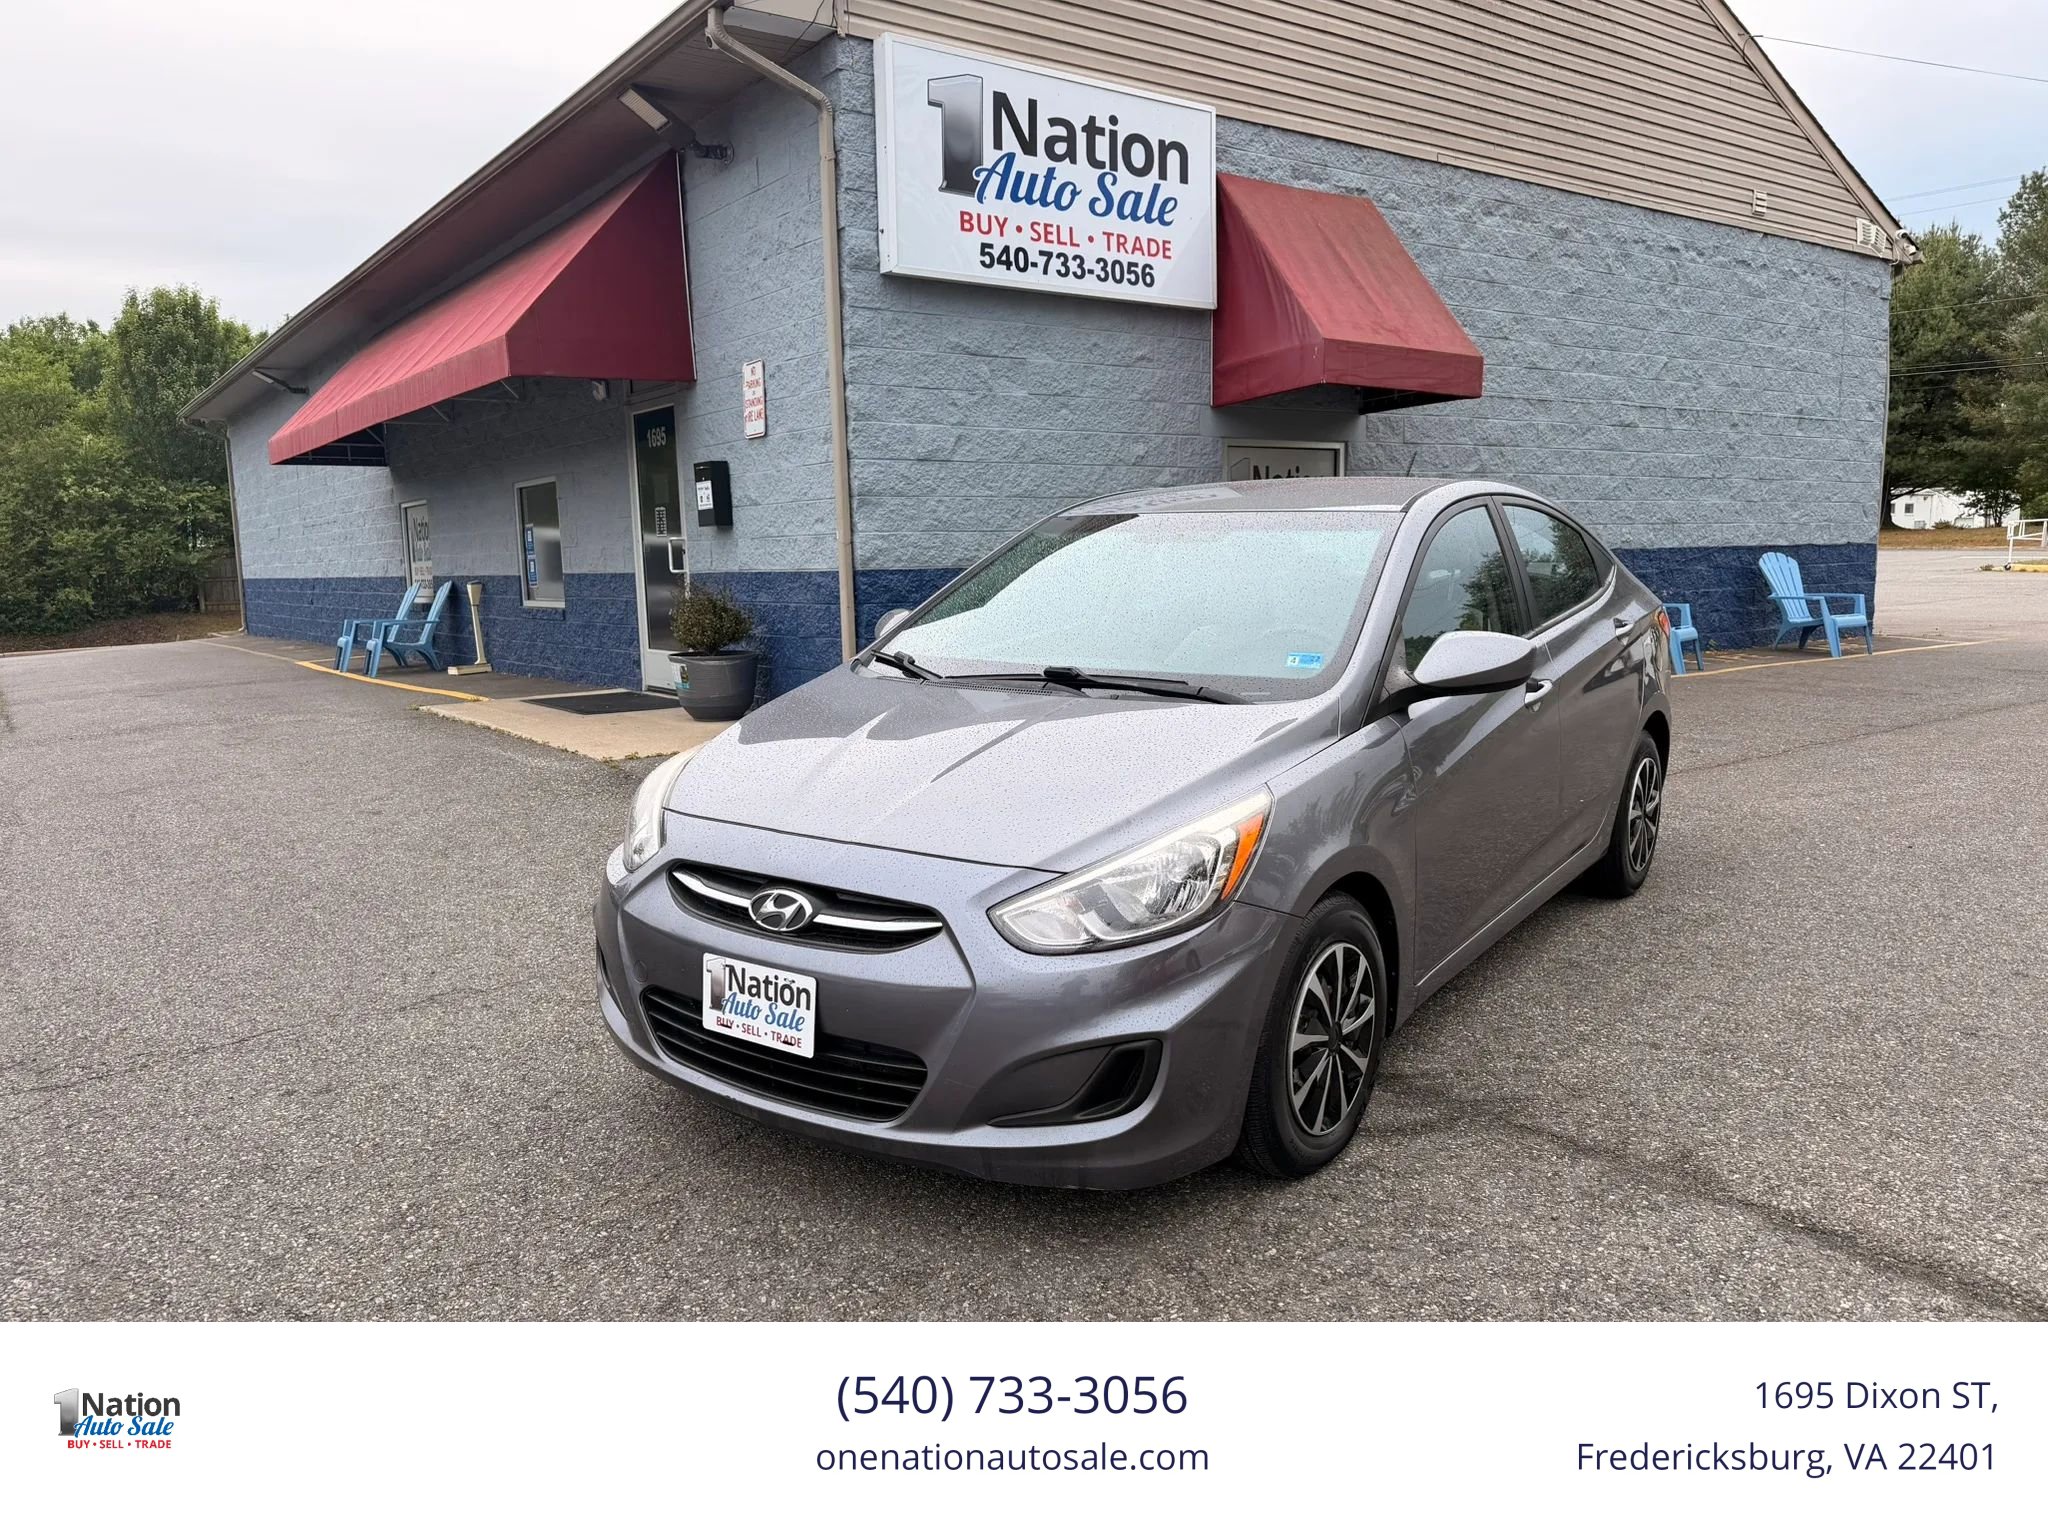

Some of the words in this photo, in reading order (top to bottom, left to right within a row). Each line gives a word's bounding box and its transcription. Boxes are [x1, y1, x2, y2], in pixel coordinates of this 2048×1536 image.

[992, 90, 1189, 185] Nation
[973, 151, 1083, 212] Auto
[1088, 171, 1179, 227] Sale
[959, 210, 1008, 238] BUY
[1029, 220, 1081, 248] SELL
[1102, 231, 1173, 260] TRADE
[979, 242, 1156, 288] 540-733-3056
[646, 426, 667, 448] 1695
[726, 963, 811, 1011] Nation
[716, 1016, 734, 1029] BUY
[741, 1023, 762, 1037] SELL
[770, 1030, 802, 1049] TRADE
[721, 991, 762, 1021] Auto
[764, 1002, 806, 1032] Sale
